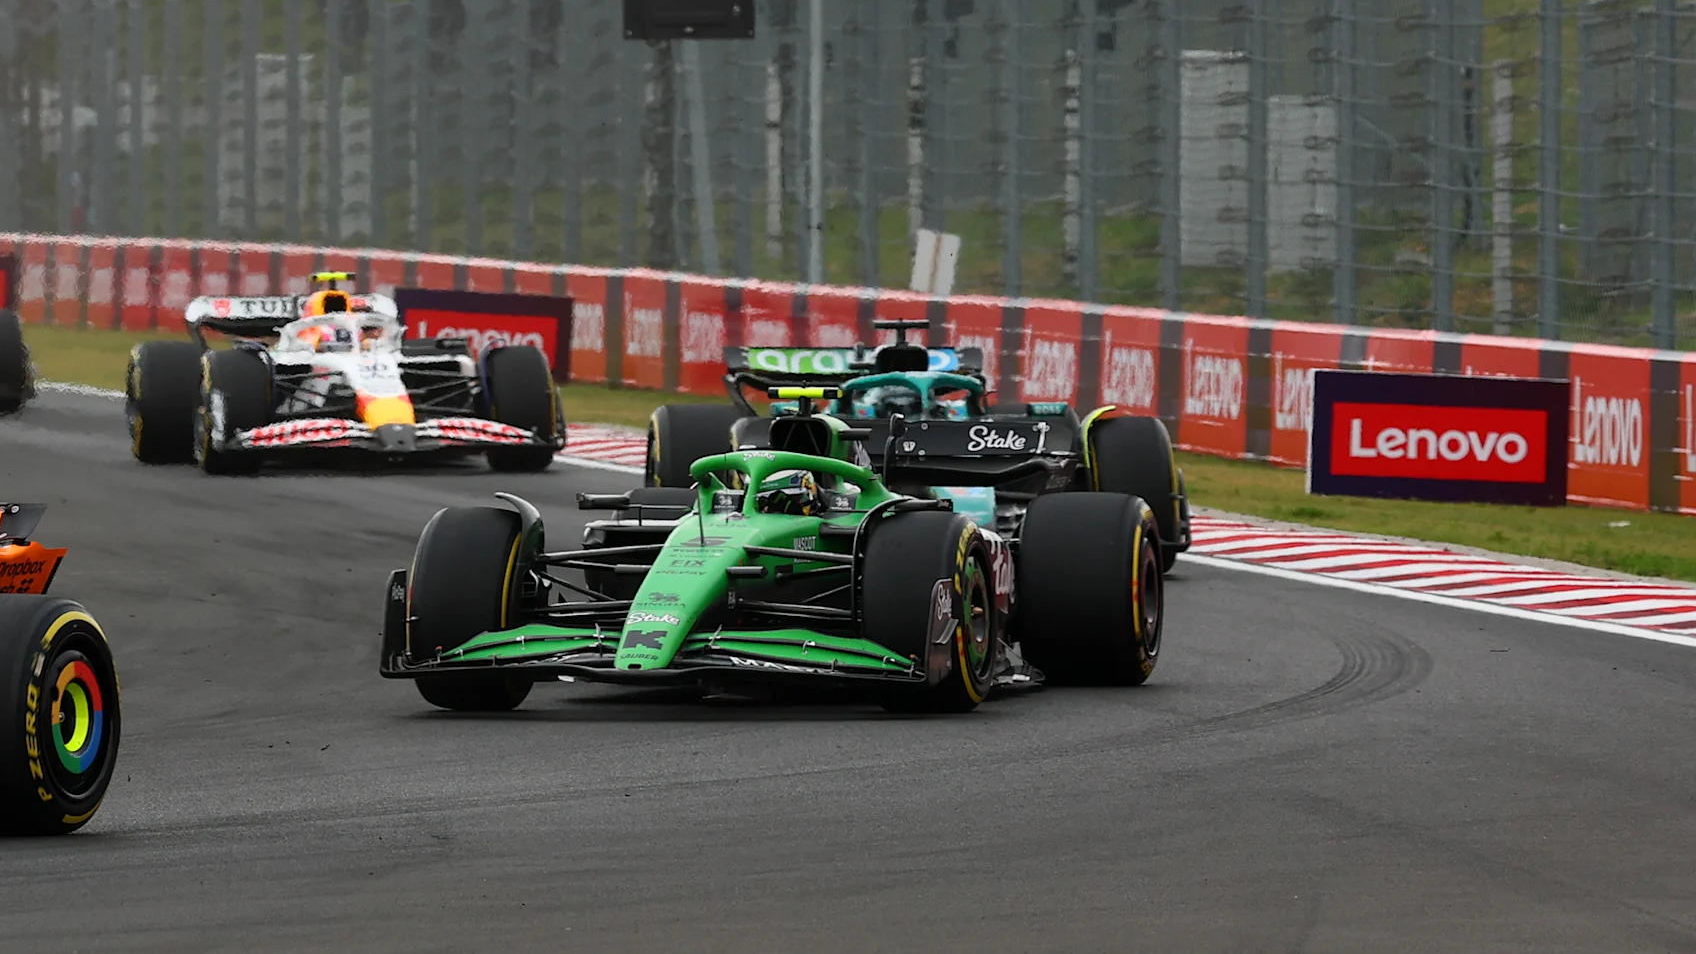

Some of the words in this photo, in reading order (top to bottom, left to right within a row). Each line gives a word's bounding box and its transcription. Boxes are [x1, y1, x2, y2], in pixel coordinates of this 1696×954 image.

[756, 348, 951, 374] arao
[967, 425, 1026, 451] Stake
[1574, 376, 1643, 466] Lenovo
[1349, 418, 1529, 464] Lenovo
[627, 613, 681, 626] Stake
[25, 681, 43, 780] ZERO
